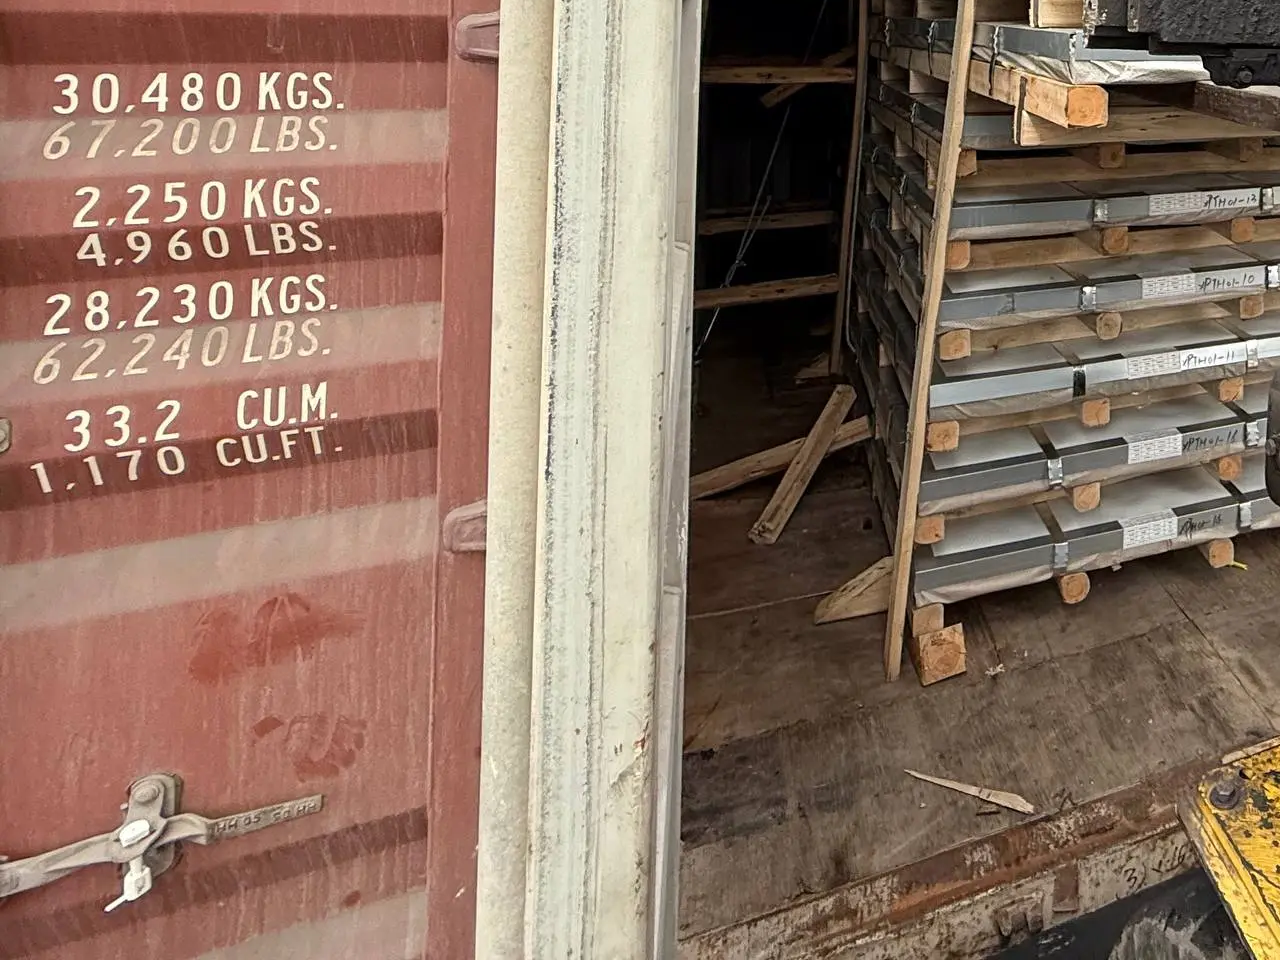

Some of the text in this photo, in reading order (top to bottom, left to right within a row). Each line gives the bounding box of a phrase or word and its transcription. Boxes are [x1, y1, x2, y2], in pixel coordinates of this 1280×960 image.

[258, 71, 345, 110] KGS.
[250, 115, 338, 153] LBS.
[243, 177, 333, 218] KGS.
[245, 220, 337, 256] LBS.
[251, 274, 338, 317] KGS.
[242, 317, 331, 364] LBS.
[64, 382, 339, 452] 33.2 CU.M.
[216, 426, 343, 467] CU.FT.
